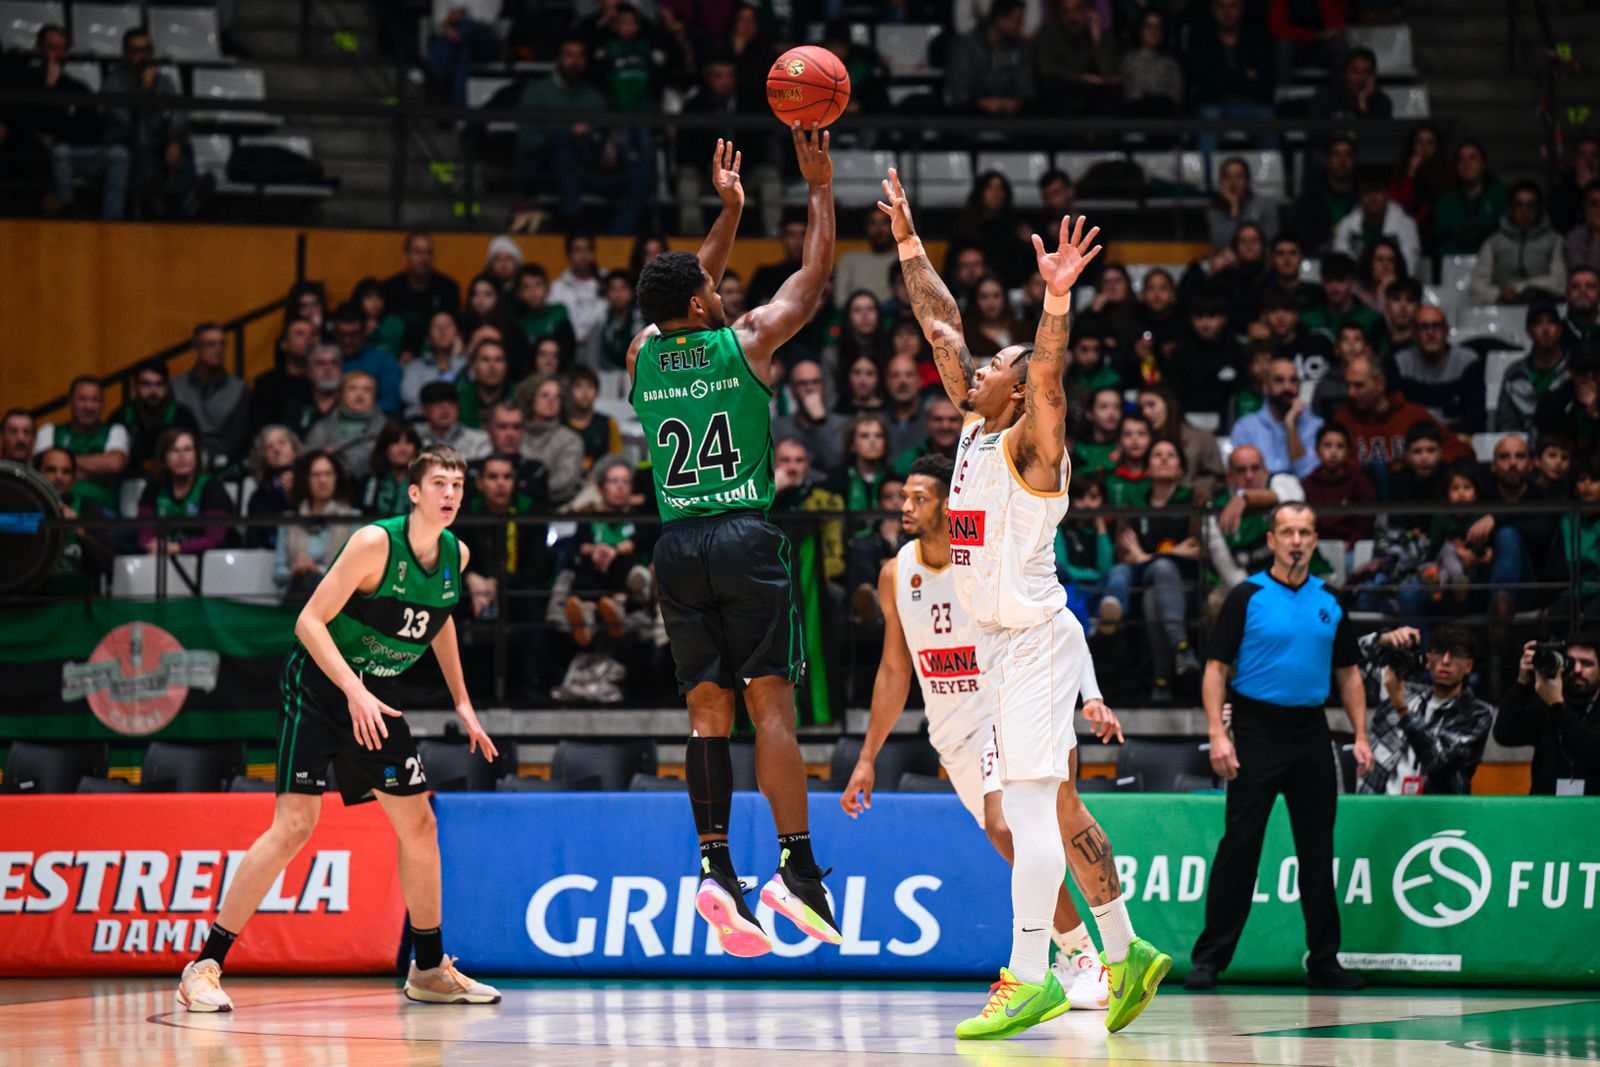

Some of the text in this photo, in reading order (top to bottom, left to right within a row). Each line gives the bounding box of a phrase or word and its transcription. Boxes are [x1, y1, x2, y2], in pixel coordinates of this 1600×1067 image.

[659, 345, 710, 372] FELIZ
[643, 377, 739, 402] BADALONA FUTUR
[657, 411, 741, 488] 24
[397, 607, 430, 639] 23
[931, 602, 952, 634] 23
[920, 650, 977, 673] UMANA
[930, 679, 979, 694] REYER
[405, 754, 426, 786] 2
[1117, 855, 1600, 908] BADLOA FUT
